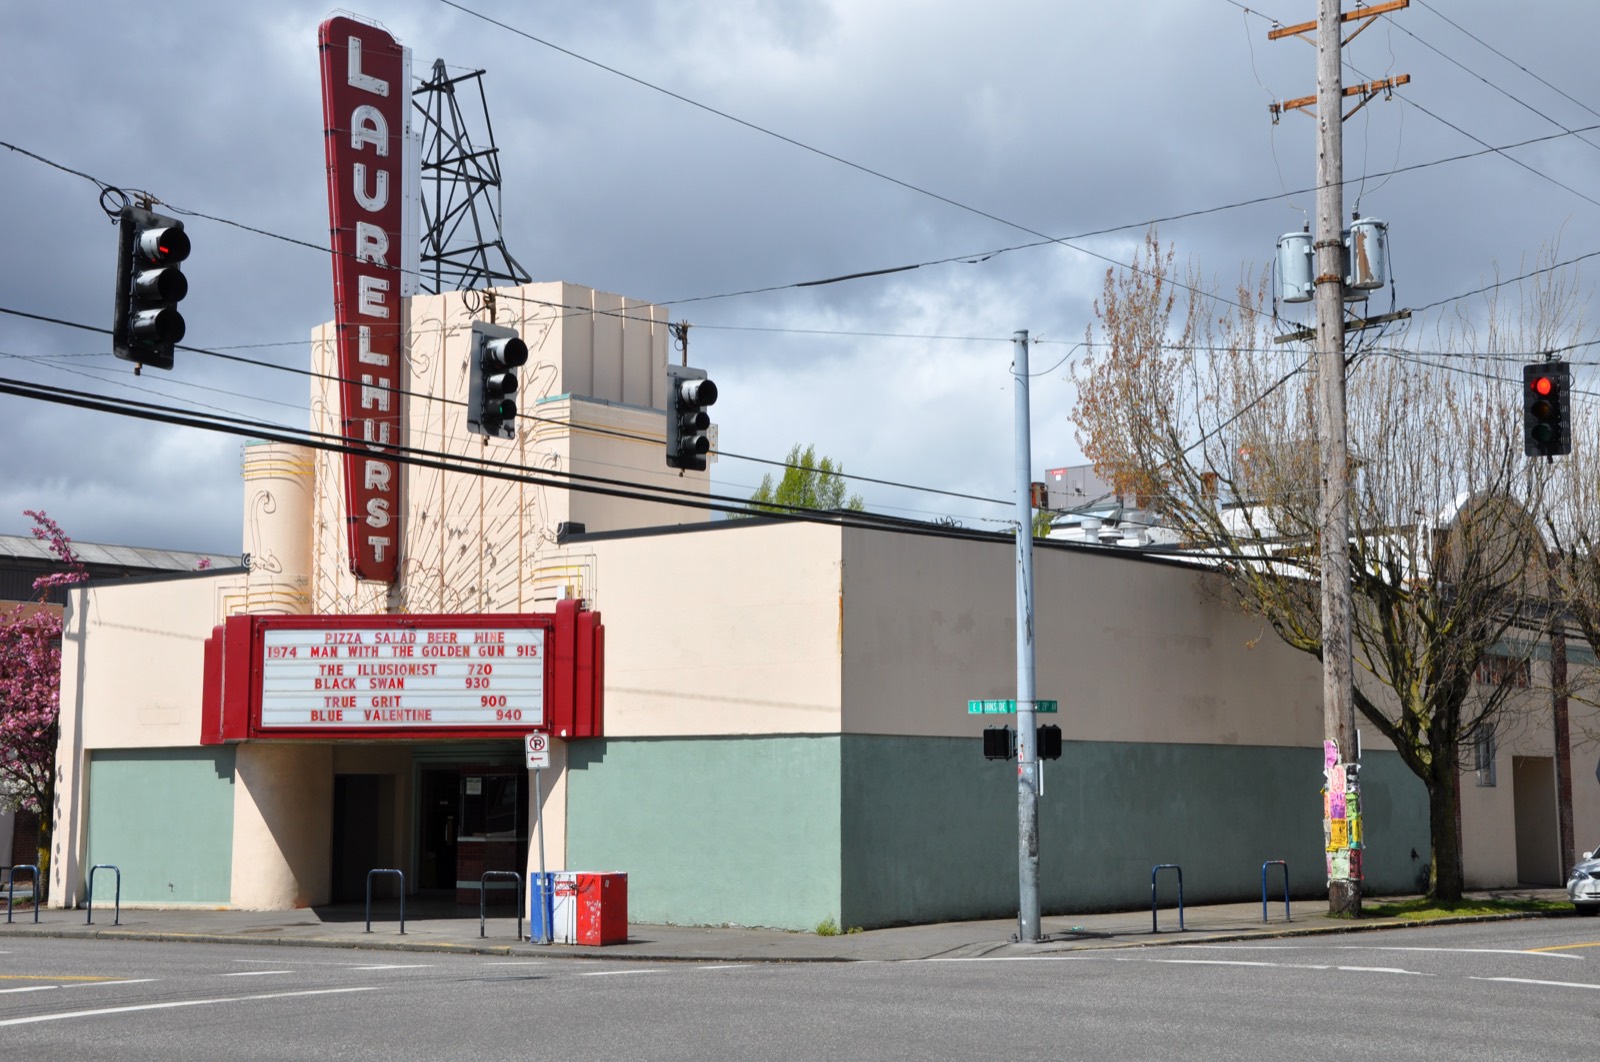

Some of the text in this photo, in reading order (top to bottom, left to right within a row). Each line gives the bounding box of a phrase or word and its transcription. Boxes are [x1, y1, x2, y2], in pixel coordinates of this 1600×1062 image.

[347, 35, 390, 563] LAURELHURST
[324, 632, 505, 645] PIZZA SALAD BEER WINE
[267, 645, 538, 658] 1974 MAN WITH THE GOLDEN GUN 915
[319, 664, 344, 676] THE
[467, 663, 493, 676] 720
[314, 677, 490, 690] BLACK SWAN 930
[324, 695, 507, 708] TRUE GRIT 900
[310, 708, 522, 722] BLUE VALENTINE 940
